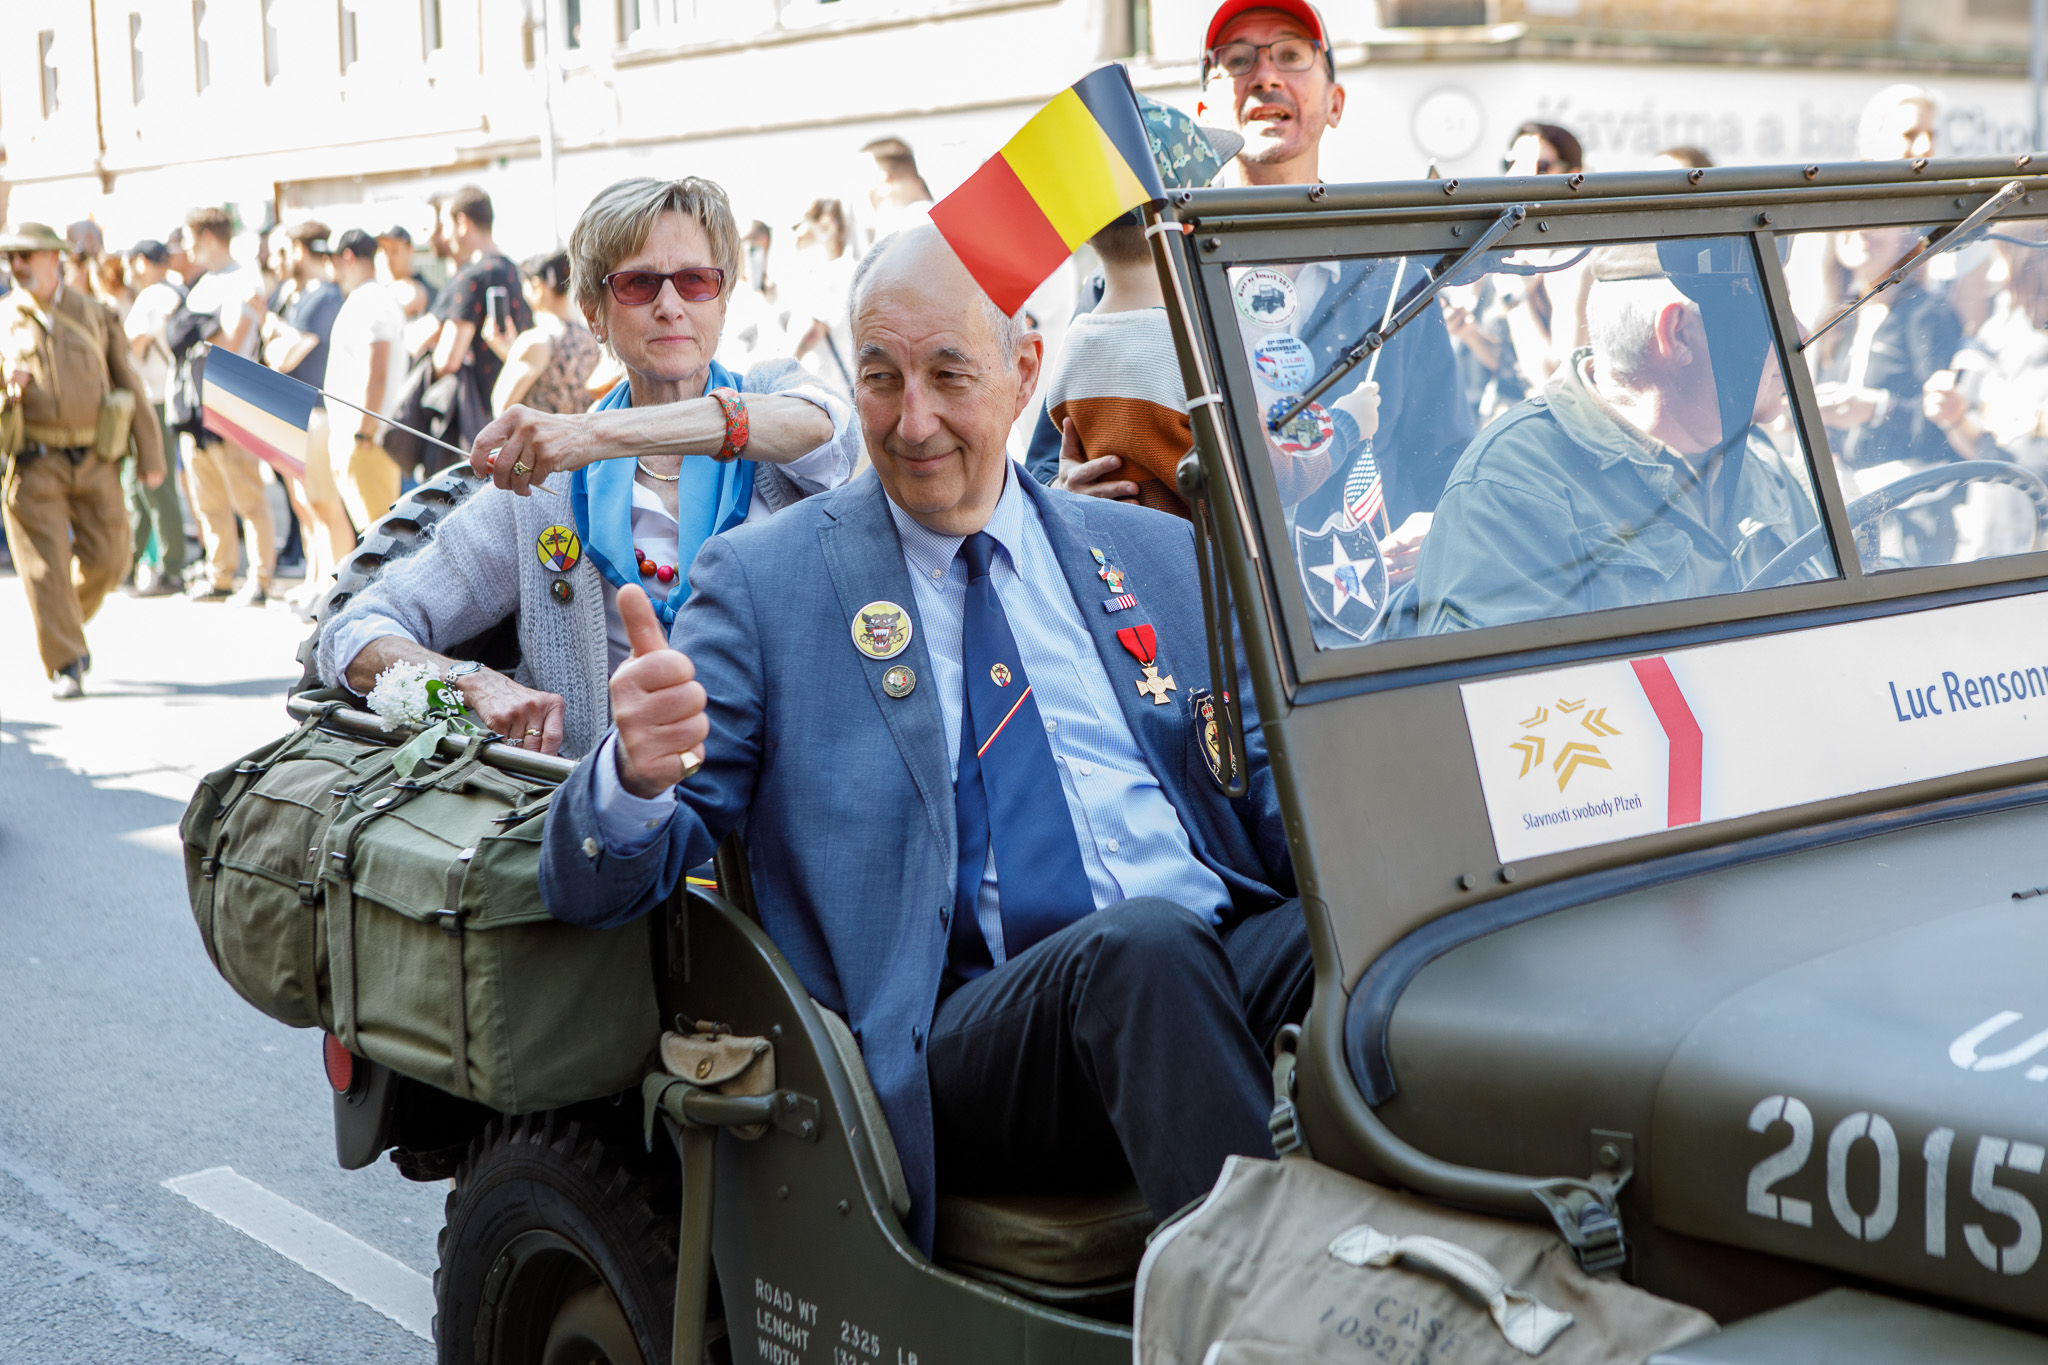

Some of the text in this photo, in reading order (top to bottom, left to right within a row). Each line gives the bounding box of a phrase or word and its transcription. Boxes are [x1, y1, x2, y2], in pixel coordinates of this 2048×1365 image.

[1754, 114, 1786, 157] a
[1889, 681, 1943, 722] Luc
[1522, 793, 1643, 830] Slavnosti svobody Plzeň
[1746, 1095, 2046, 1276] 2015
[755, 1276, 793, 1314] ROAD
[797, 1297, 818, 1327] WT
[840, 1319, 880, 1358] 2325
[756, 1306, 810, 1352] LENGHT
